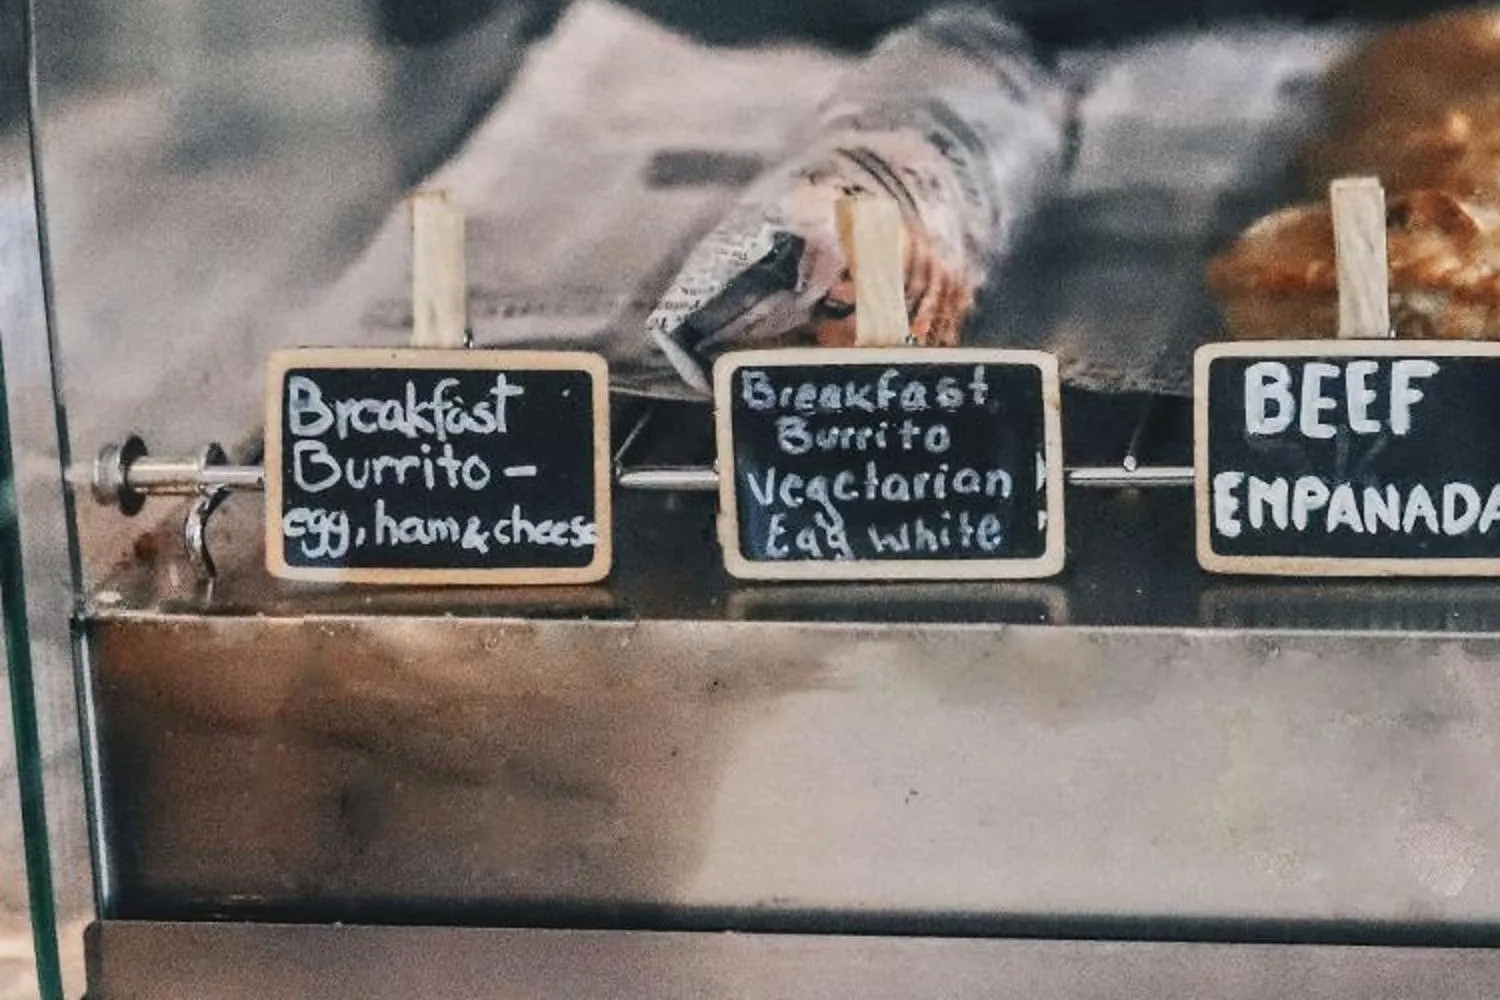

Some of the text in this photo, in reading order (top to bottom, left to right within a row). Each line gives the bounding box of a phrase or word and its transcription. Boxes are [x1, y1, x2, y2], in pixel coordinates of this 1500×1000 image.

[289, 372, 525, 442] Breakfast
[741, 364, 990, 414] Breakfast
[1244, 359, 1441, 439] BEEF
[775, 415, 951, 454] Burrito
[747, 460, 1013, 530] Vegetarian
